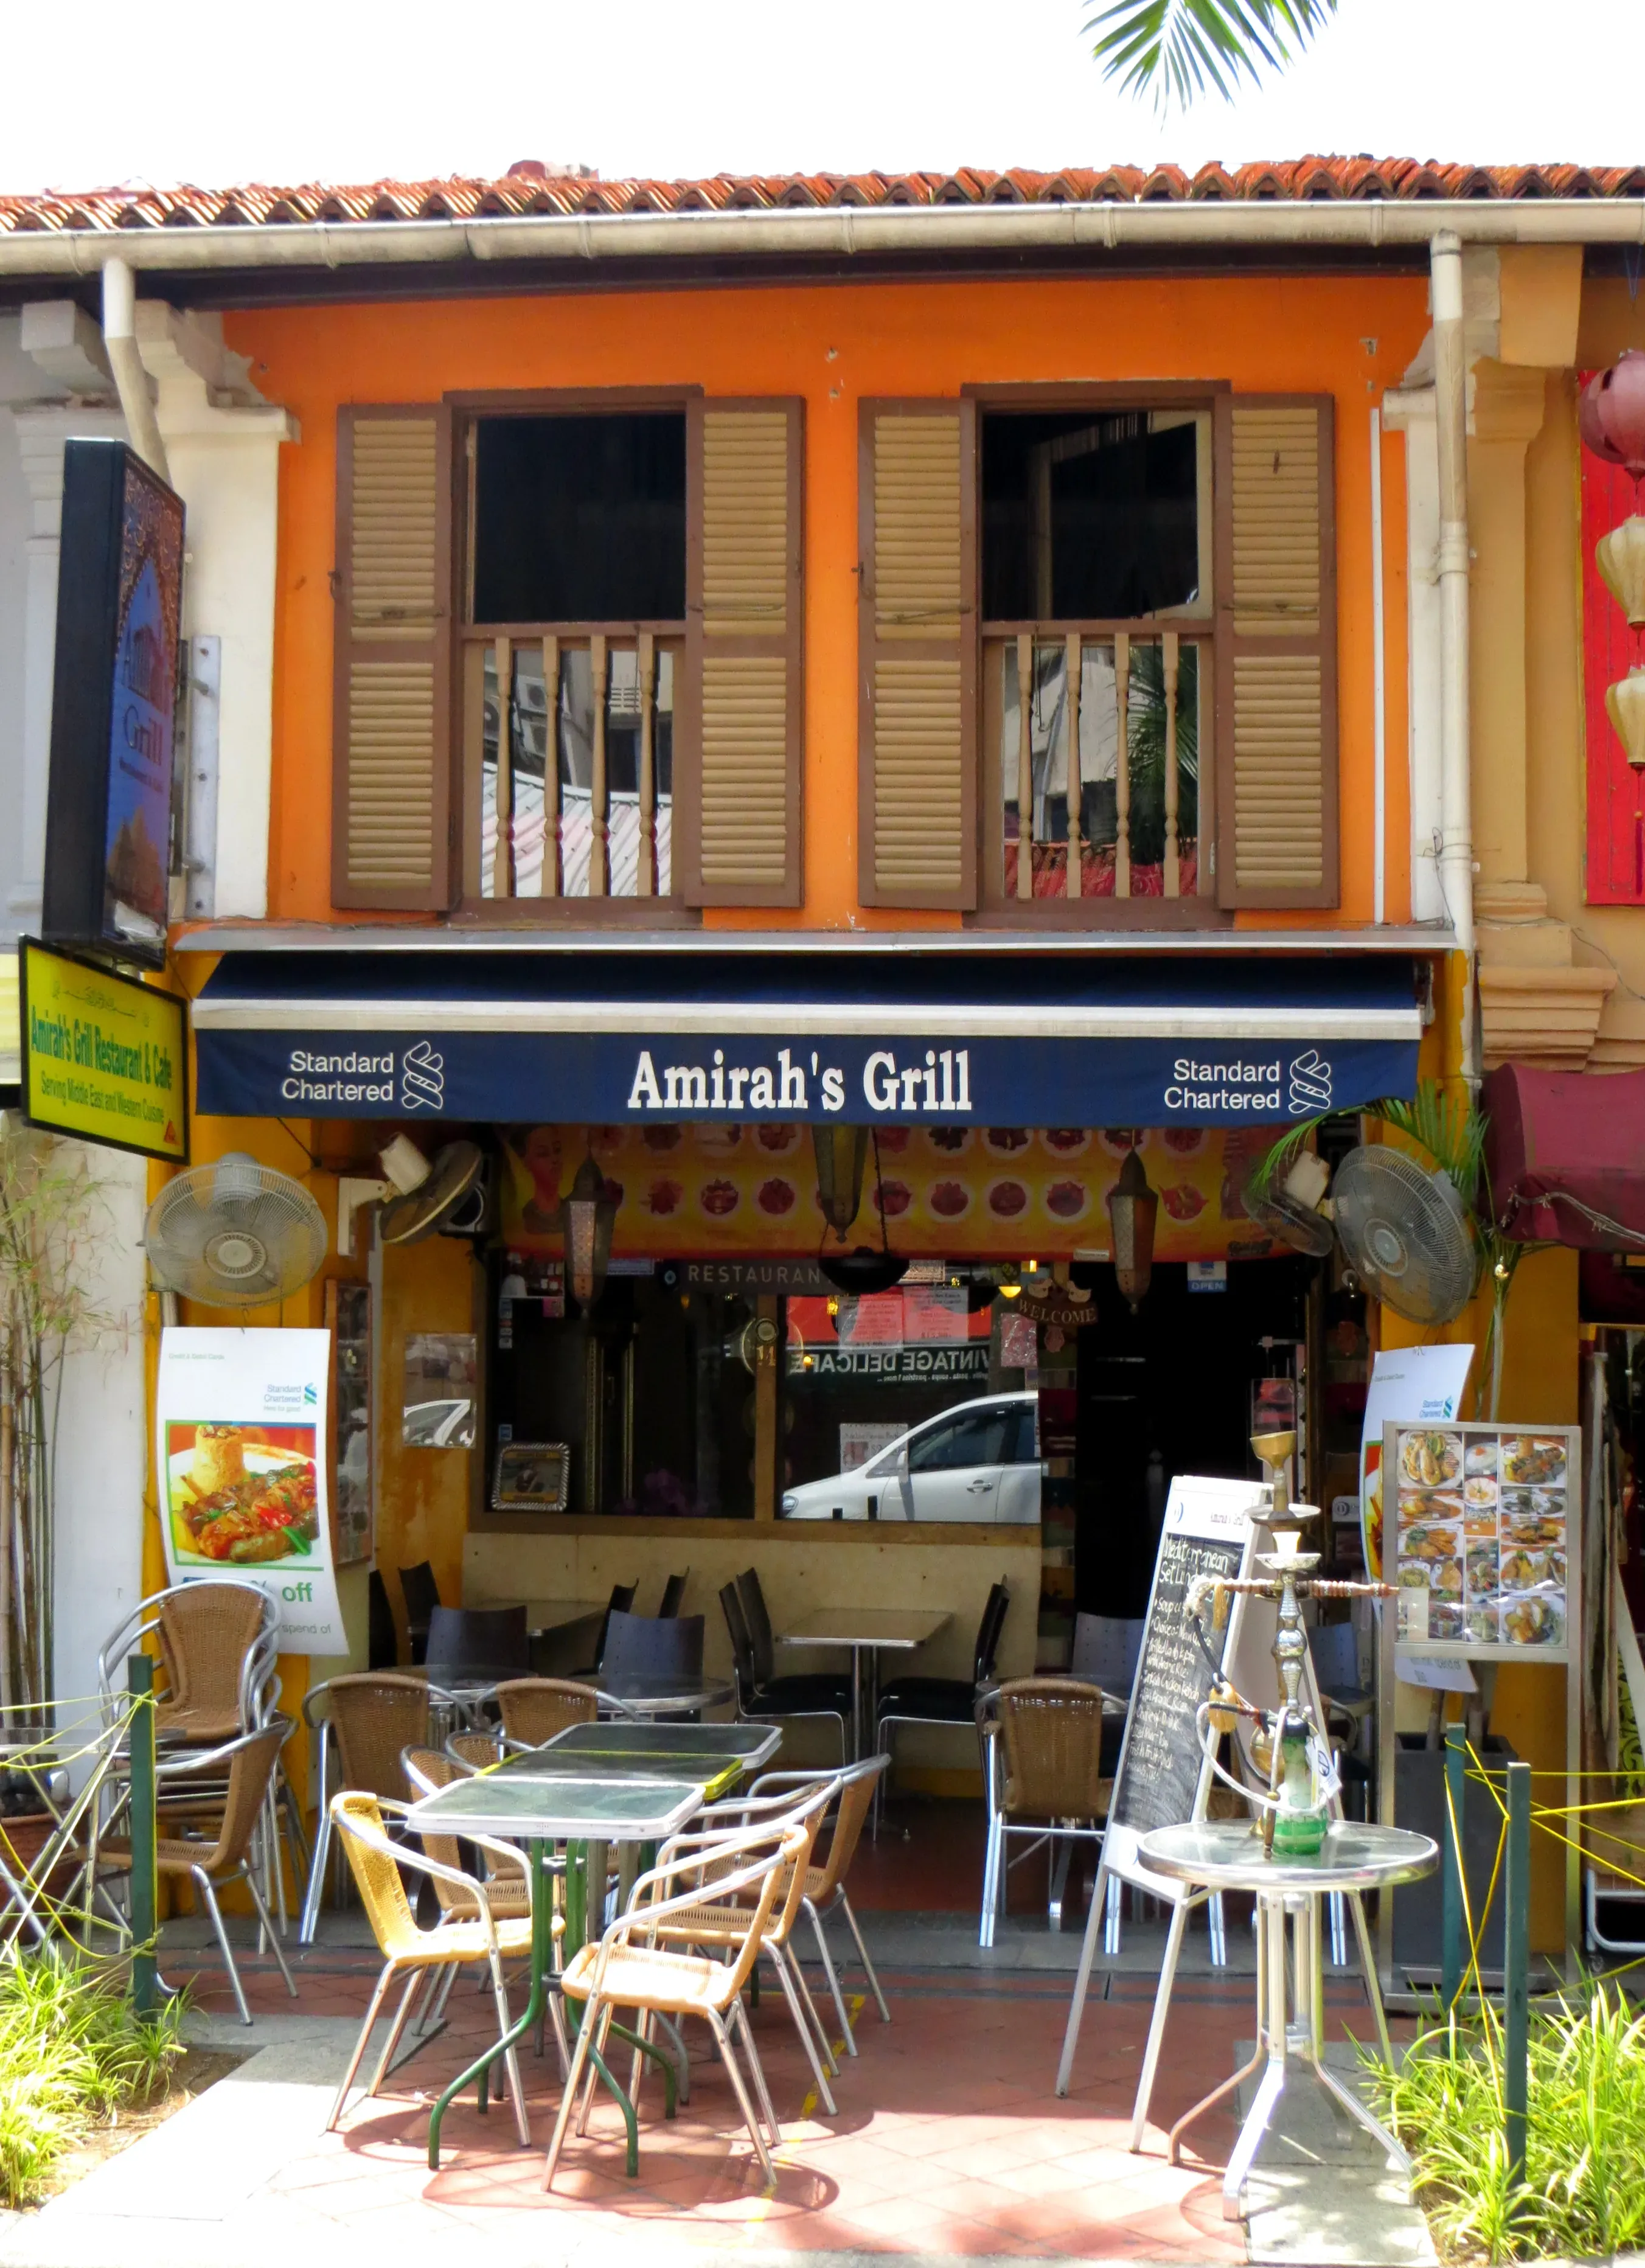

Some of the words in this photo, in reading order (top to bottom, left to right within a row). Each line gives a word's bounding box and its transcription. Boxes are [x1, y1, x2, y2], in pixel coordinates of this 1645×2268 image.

[94, 1025, 143, 1083] Restaurant
[290, 1051, 394, 1074] Standard
[627, 1048, 846, 1111] Amirah's
[863, 1049, 972, 1111] Grill
[1173, 1059, 1281, 1082] Standard
[282, 1078, 394, 1102] Chartered
[1163, 1087, 1281, 1110] Chartered
[688, 1264, 832, 1285] RESTAURAN
[1192, 1281, 1224, 1290] OPEN
[1019, 1298, 1096, 1324] WELCOME
[264, 1393, 301, 1403] Chartered
[268, 1383, 301, 1393] Standard
[1159, 1560, 1176, 1585] Set
[282, 1581, 313, 1602] off
[282, 1624, 318, 1635] spend
[320, 1623, 332, 1634] of
